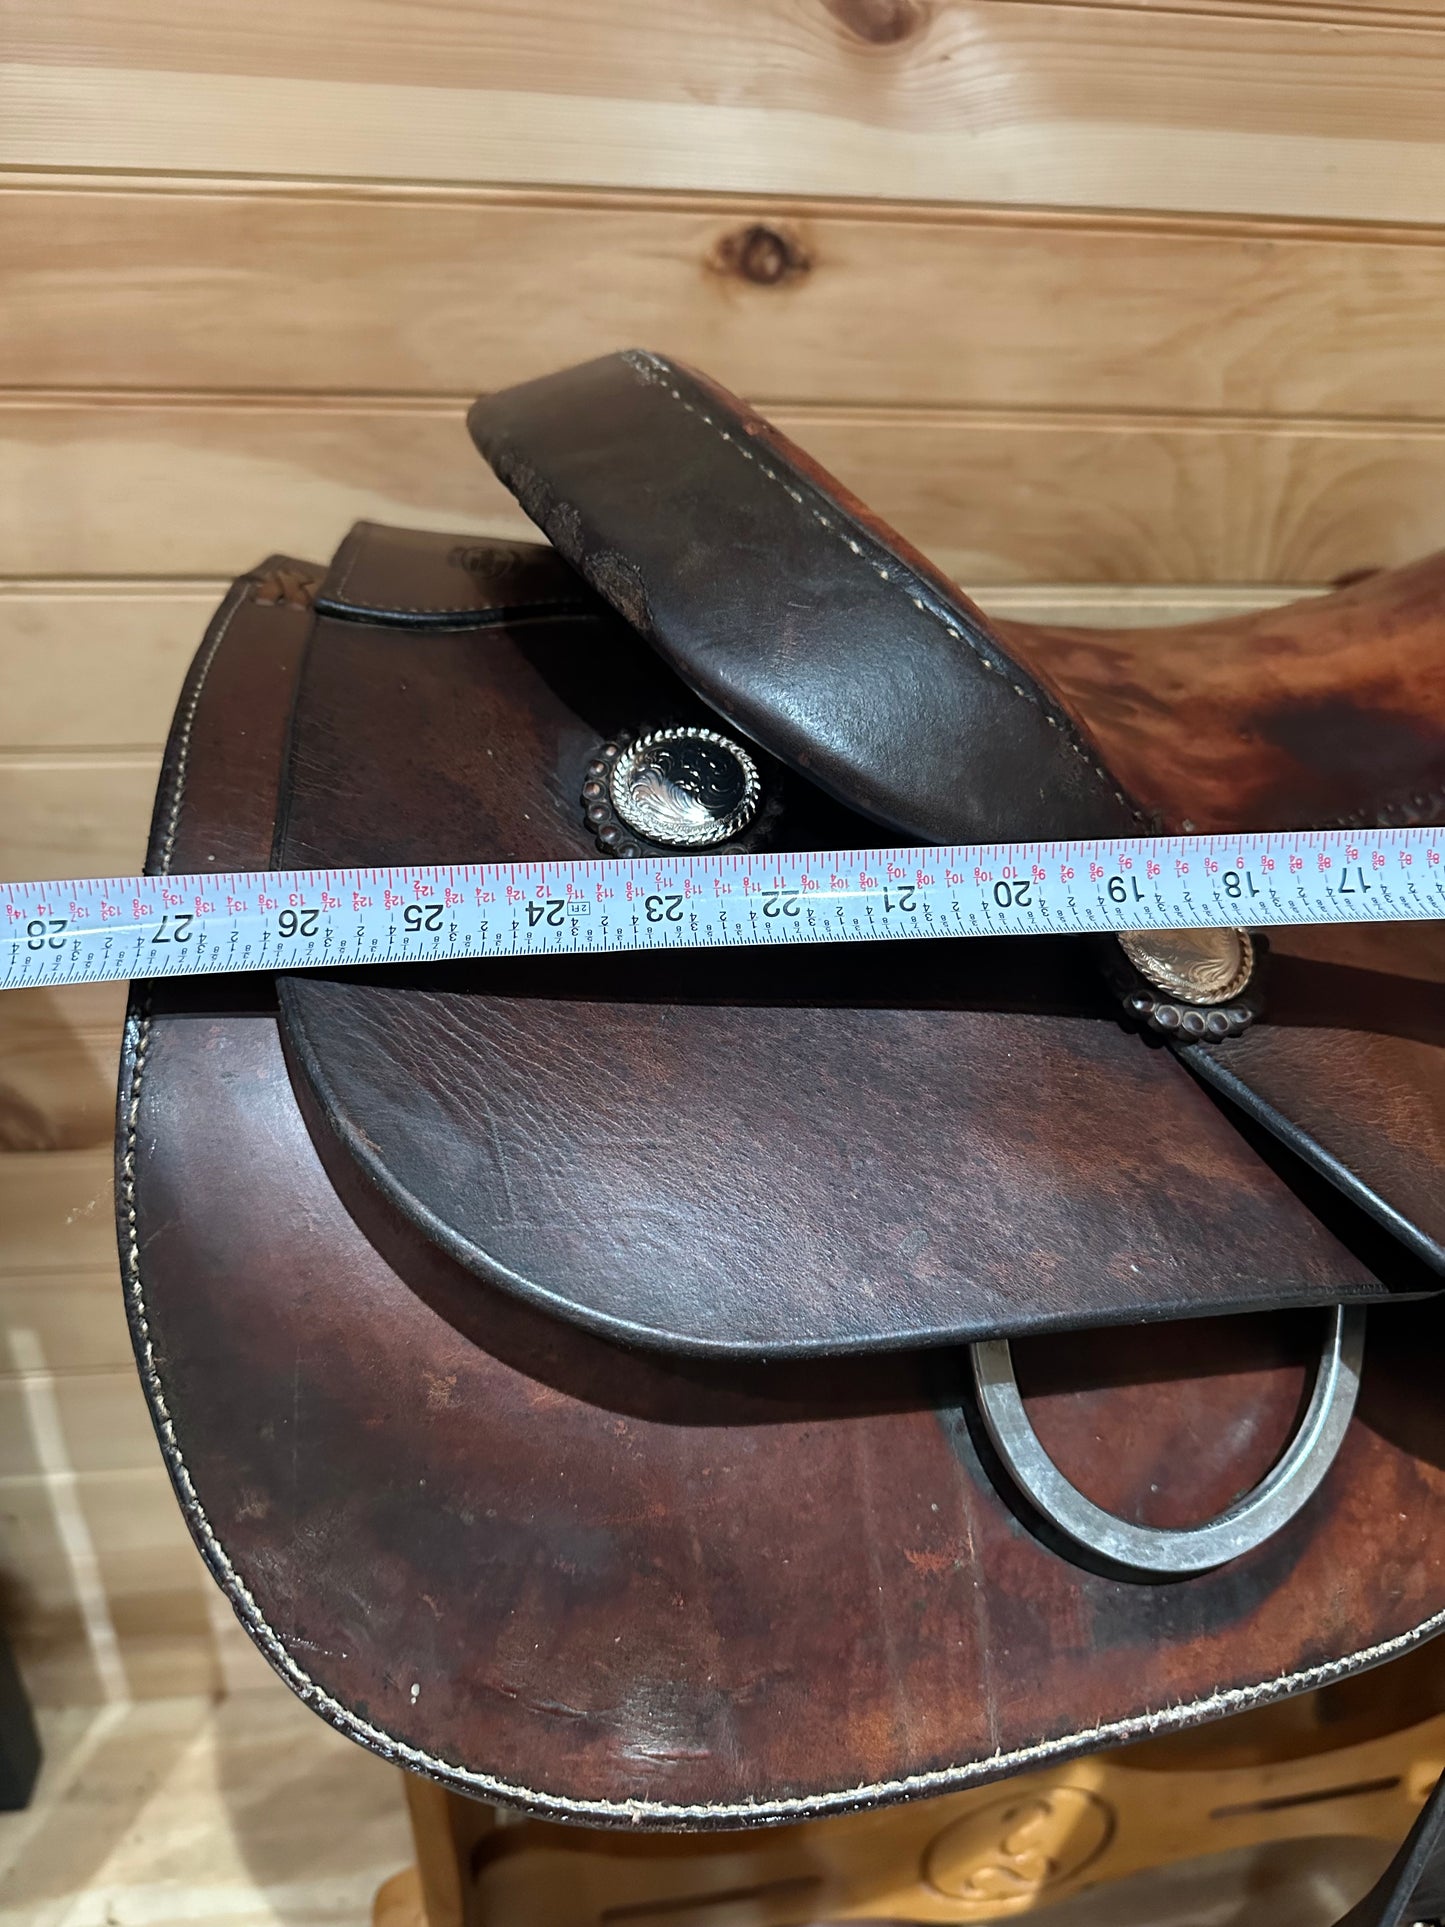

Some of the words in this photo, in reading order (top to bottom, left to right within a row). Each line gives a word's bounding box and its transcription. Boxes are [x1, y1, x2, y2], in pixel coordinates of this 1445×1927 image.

[1002, 866, 1017, 878] 10
[1236, 857, 1244, 868] 9
[536, 885, 551, 898] 12
[774, 878, 785, 888] 11
[1108, 876, 1145, 903] 19
[1222, 871, 1260, 898] 18
[1338, 867, 1371, 893] 17
[288, 894, 305, 906] 13
[571, 904, 580, 912] Ft
[581, 904, 587, 912] 2
[762, 890, 800, 917] 22
[883, 885, 915, 912] 21
[994, 881, 1032, 908] 20
[37, 904, 53, 916] 14
[404, 904, 444, 932] 25
[525, 900, 564, 927] 24
[645, 895, 683, 922] 23
[27, 920, 68, 950] 28
[152, 914, 194, 943] 27
[278, 909, 320, 938] 26
